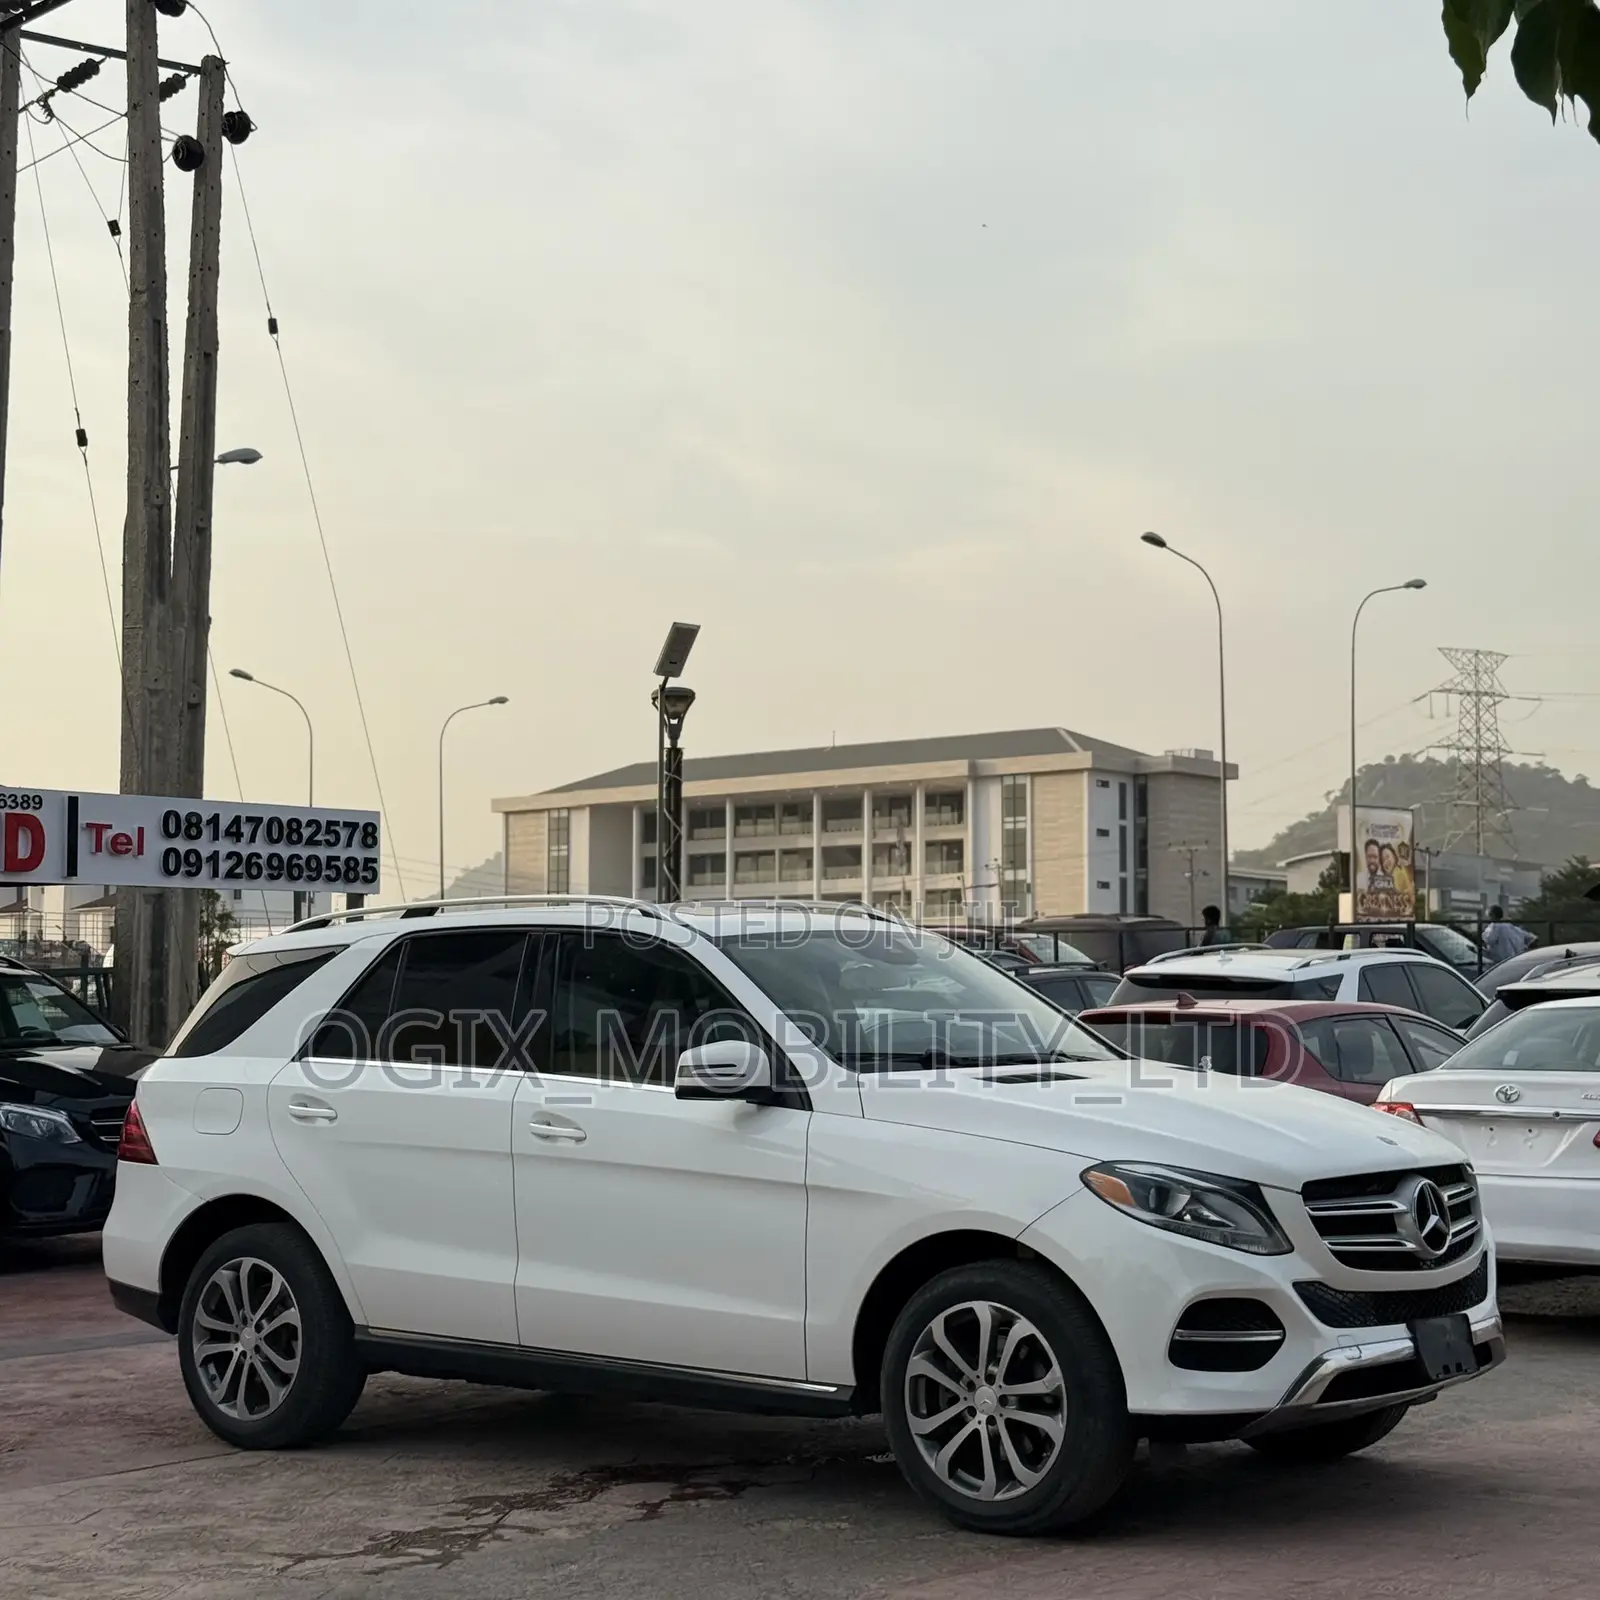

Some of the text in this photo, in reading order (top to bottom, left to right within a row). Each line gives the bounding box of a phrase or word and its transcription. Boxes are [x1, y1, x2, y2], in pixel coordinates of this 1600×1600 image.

[86, 822, 145, 856] Tel
[162, 809, 378, 848] 08147082578
[162, 848, 378, 884] 09126969585
